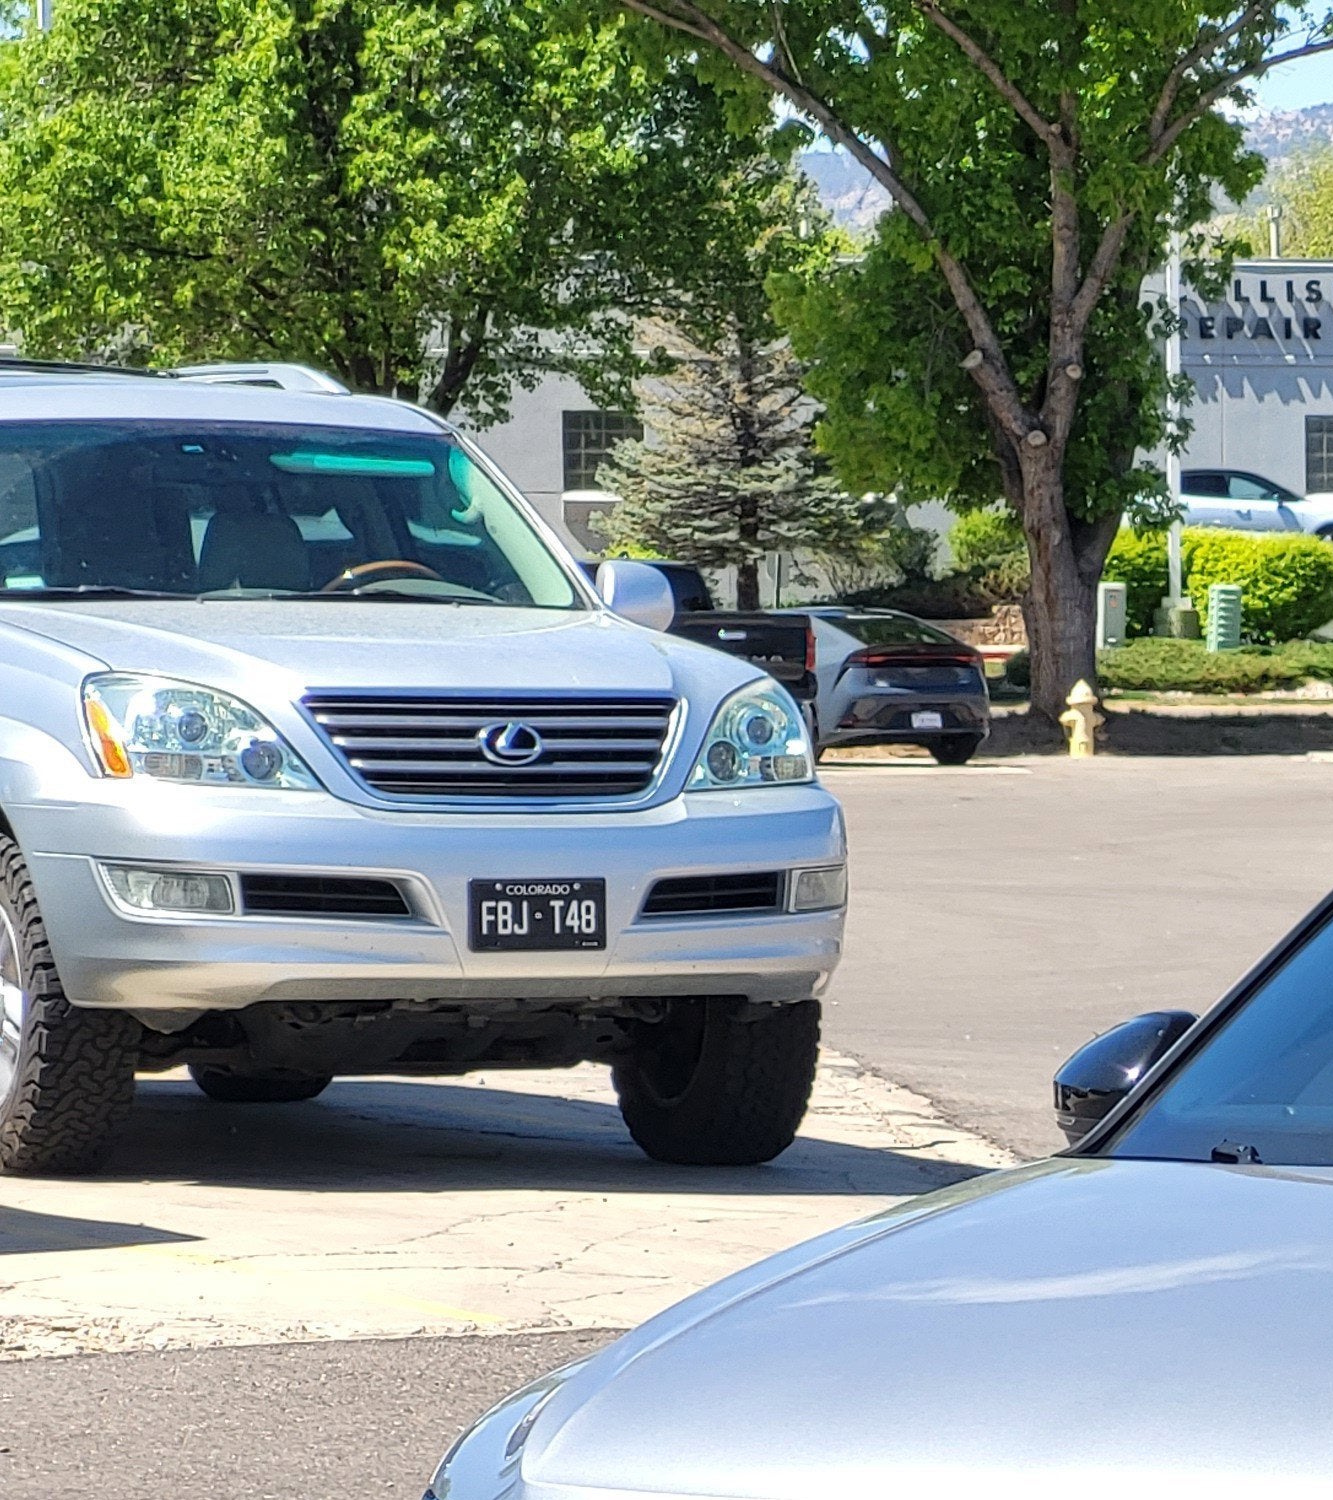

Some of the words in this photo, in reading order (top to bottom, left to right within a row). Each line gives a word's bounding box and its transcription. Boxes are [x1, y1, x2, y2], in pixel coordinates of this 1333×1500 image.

[505, 884, 570, 895] COLORADO
[481, 900, 528, 935] FBJ
[550, 900, 596, 934] T48
